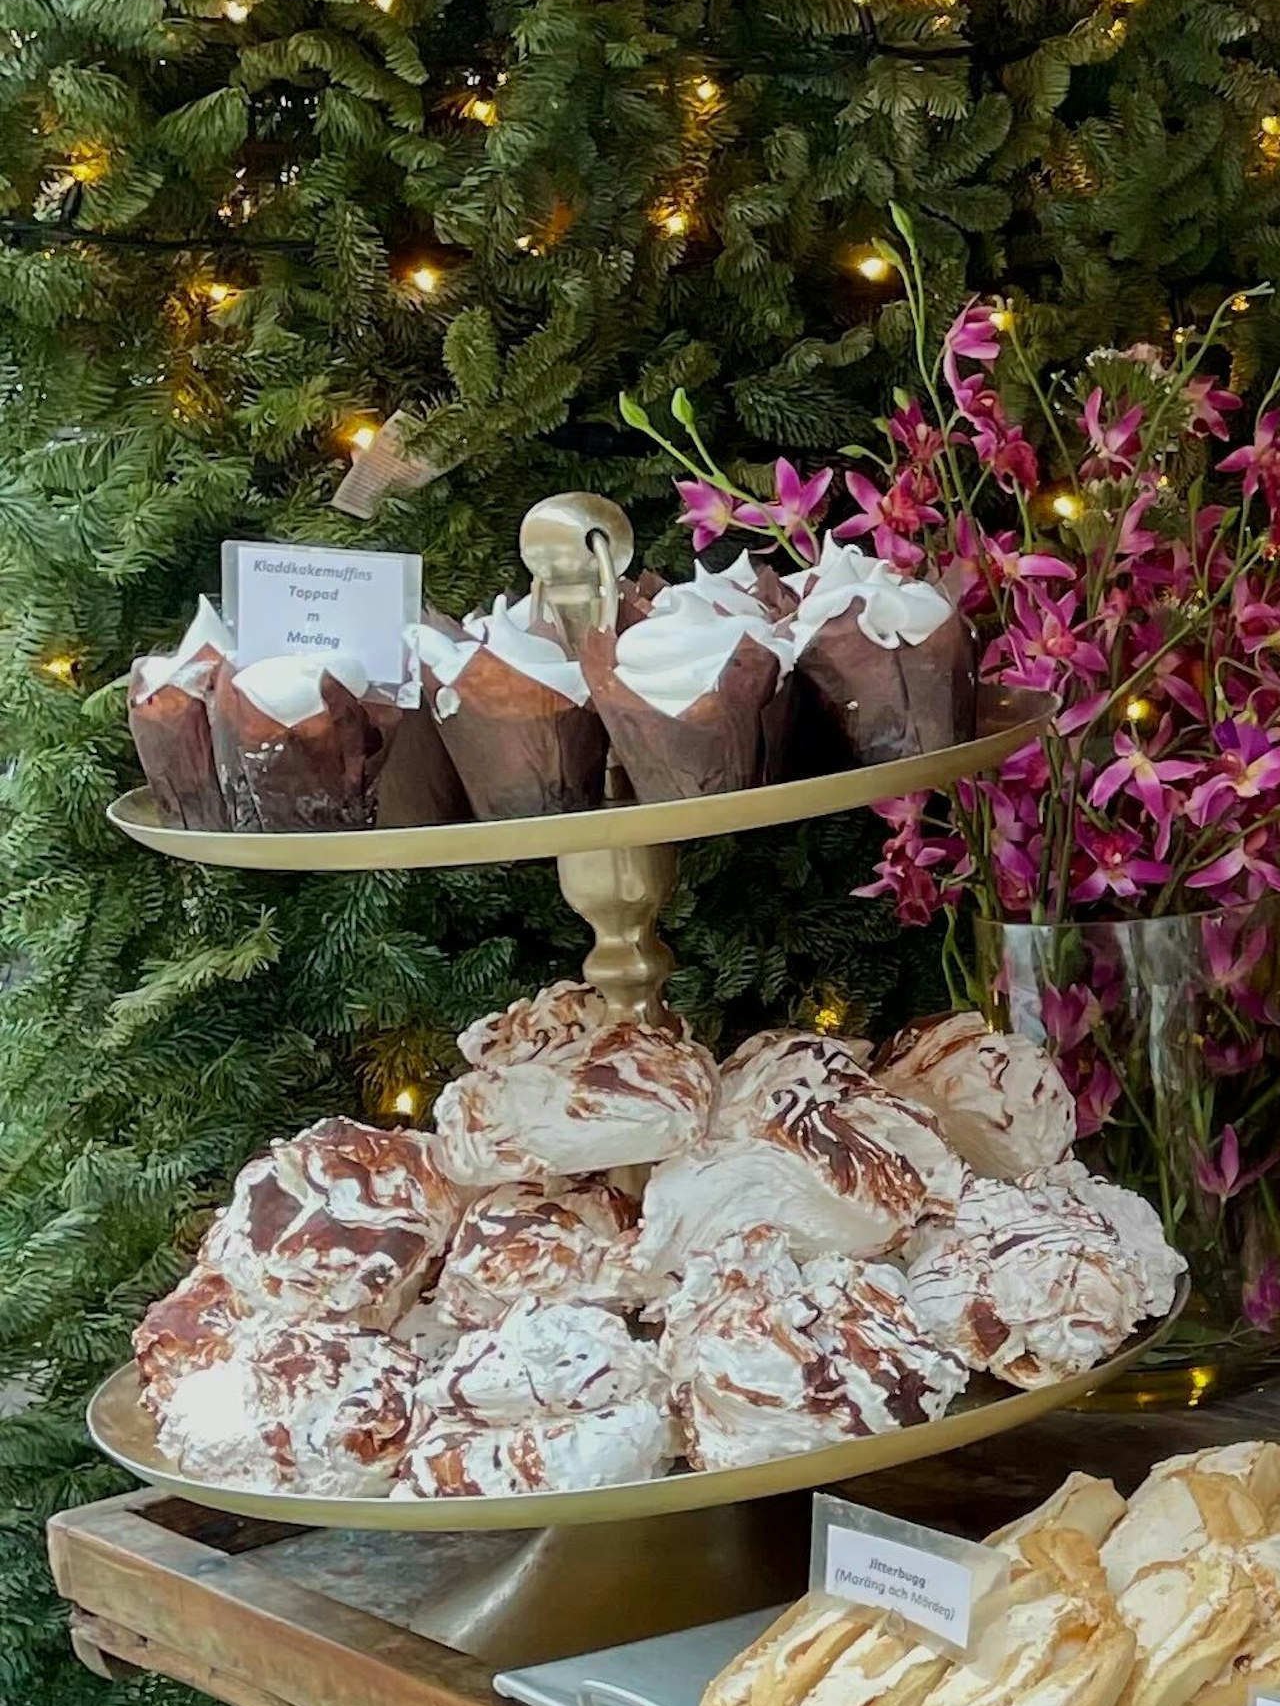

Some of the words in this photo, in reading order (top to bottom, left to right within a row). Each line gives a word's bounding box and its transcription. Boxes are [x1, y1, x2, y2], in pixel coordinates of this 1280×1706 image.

[253, 559, 373, 582] Kladdkakemuffins
[288, 585, 340, 602] Toppad
[306, 612, 320, 622] m
[286, 631, 341, 649] Maräng
[869, 1558, 926, 1589] Jitterbugg
